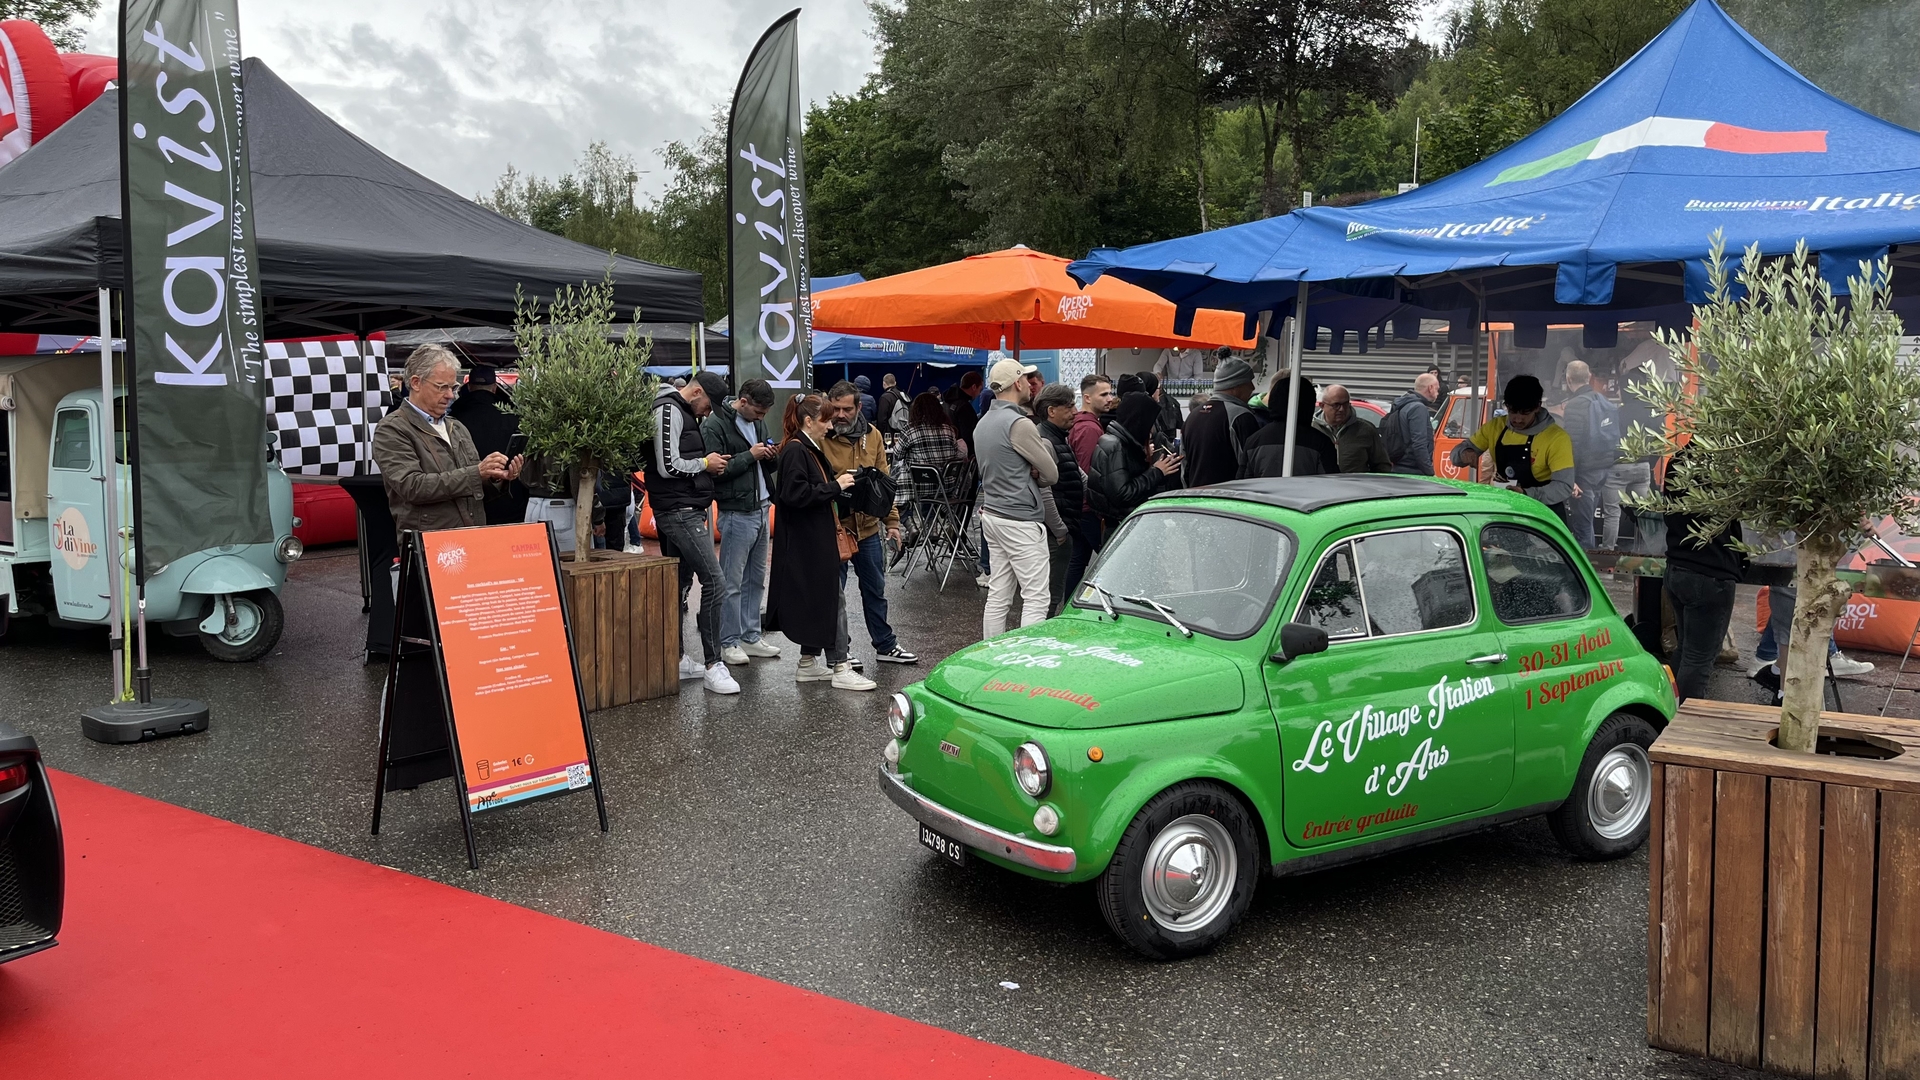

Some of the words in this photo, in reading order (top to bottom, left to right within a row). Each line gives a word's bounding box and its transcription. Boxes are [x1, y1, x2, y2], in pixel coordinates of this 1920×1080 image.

[133, 20, 228, 386] kavist
[790, 183, 805, 243] discover
[1686, 199, 1809, 211] Buongiorno
[232, 199, 247, 241] way
[1433, 215, 1534, 239] Italia
[736, 143, 801, 389] kavist
[798, 246, 805, 259] to
[229, 245, 257, 326] simplest
[799, 263, 808, 292] way
[1057, 295, 1094, 314] APEROL
[800, 295, 813, 349] simplest
[882, 341, 905, 353] Italia
[63, 521, 74, 536] La
[64, 537, 98, 554] diVine
[437, 547, 466, 565] APEROL
[511, 543, 540, 553] CAMPARI
[1841, 603, 1878, 619] ROL
[1518, 641, 1570, 678] 30-31
[1573, 627, 1613, 660] Août
[983, 679, 1031, 693] Entrée
[1028, 685, 1101, 711] gratuite
[1524, 688, 1533, 710] 1
[1538, 657, 1625, 705] Septembre
[1293, 720, 1335, 773] Le
[1336, 704, 1422, 763] Village
[1427, 675, 1495, 730] Italien
[511, 757, 523, 767] 1€
[1364, 764, 1386, 795] d'
[1387, 737, 1450, 797] Ans
[477, 791, 498, 809] Ape
[1302, 815, 1354, 841] Entrée
[1357, 803, 1419, 834] gratuite
[922, 827, 946, 853] 134798
[948, 842, 960, 860] CS
